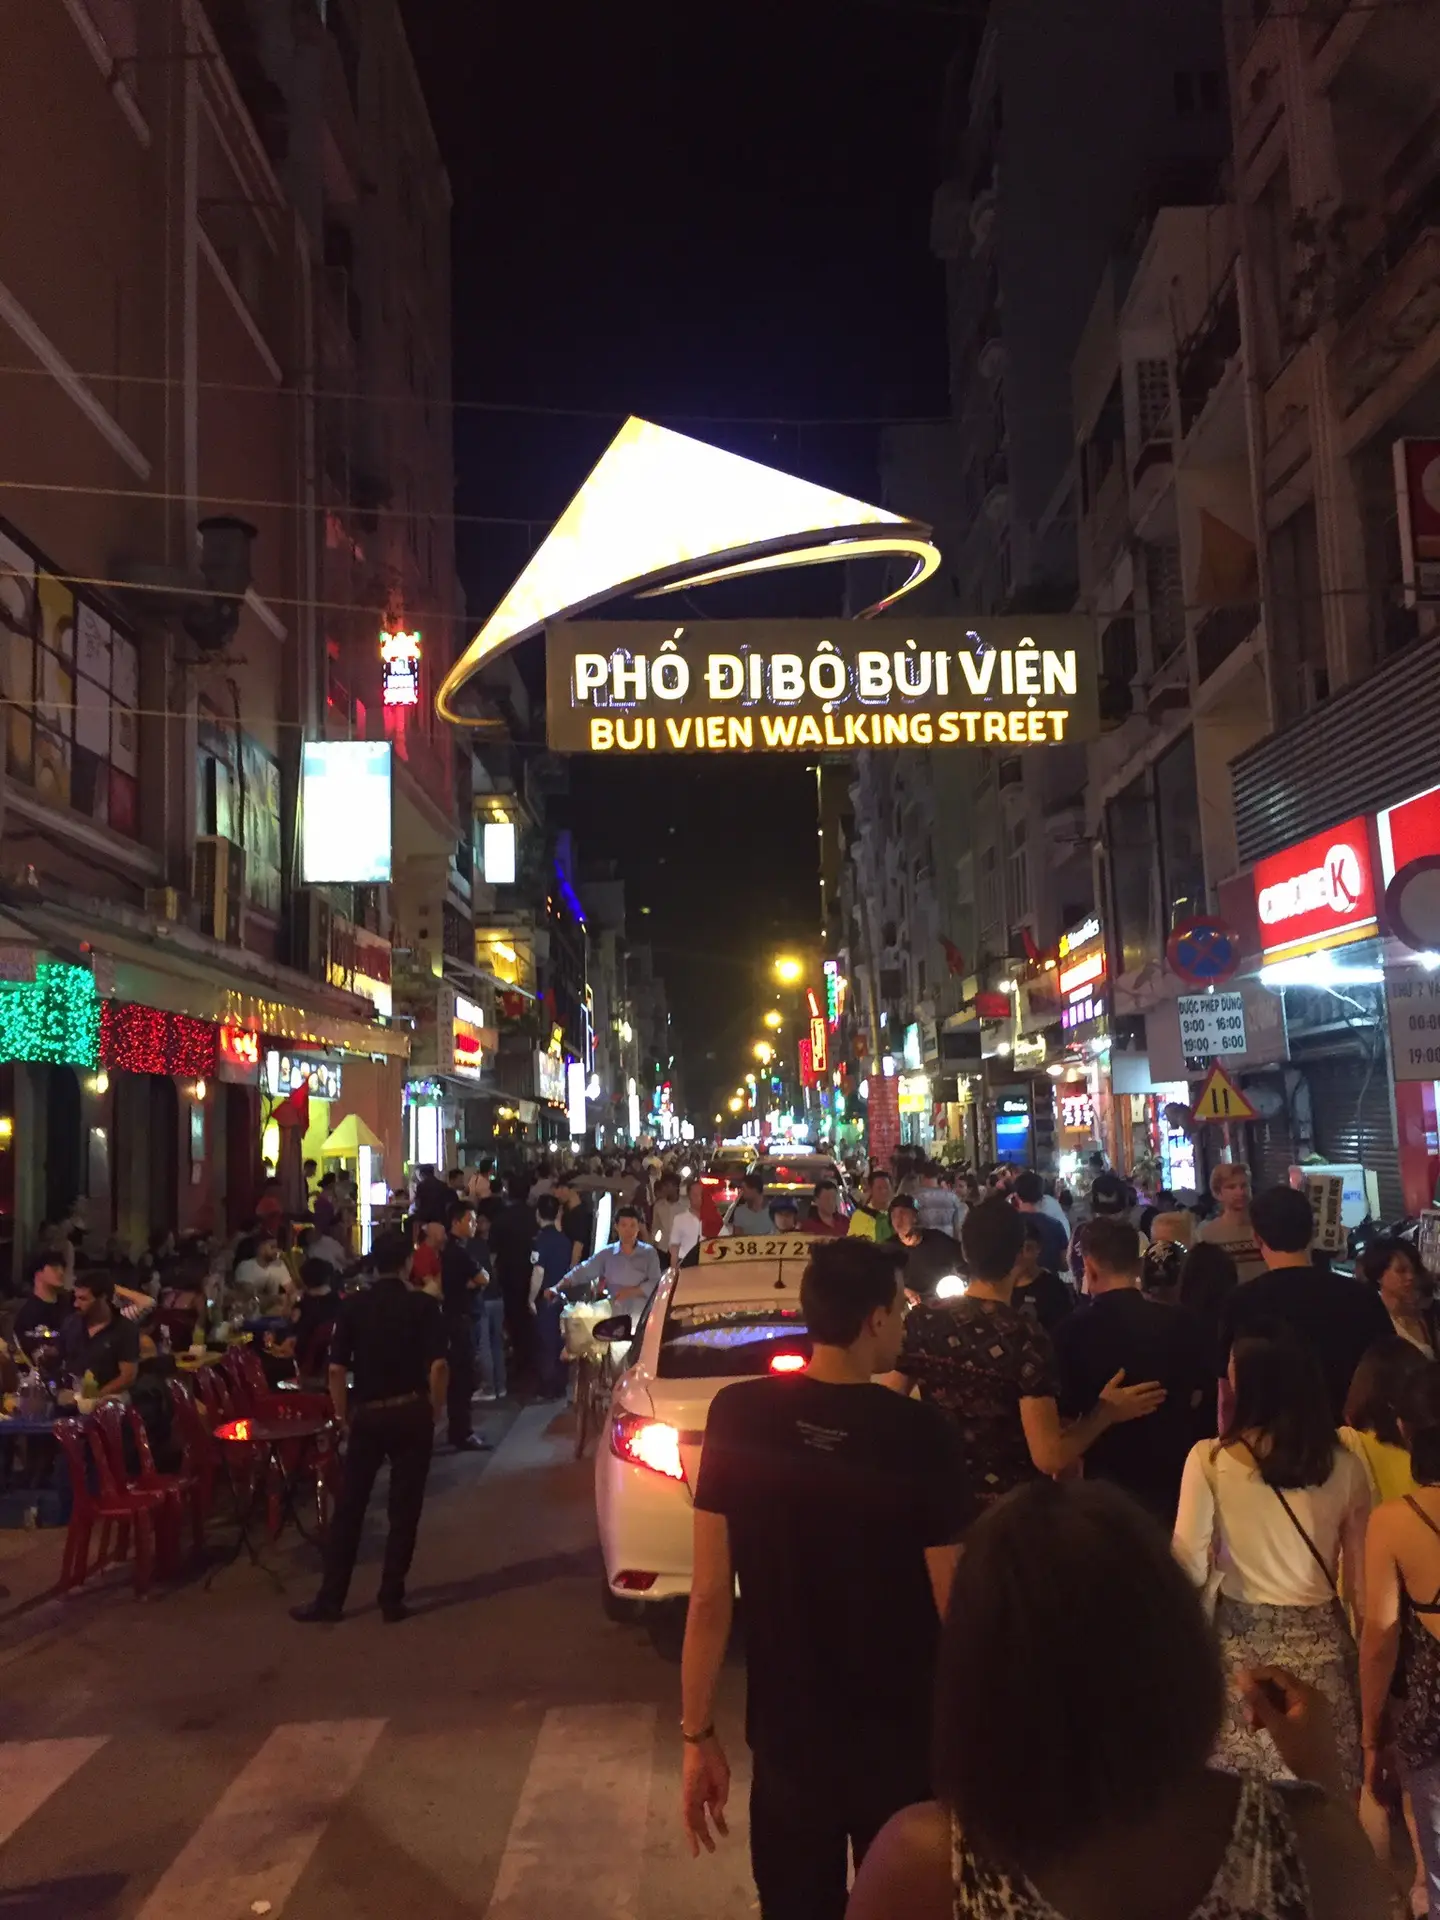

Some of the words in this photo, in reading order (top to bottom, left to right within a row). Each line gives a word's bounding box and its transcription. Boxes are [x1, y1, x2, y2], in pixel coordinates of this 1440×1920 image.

[575, 627, 690, 700] PHỐ
[858, 639, 949, 697] BÙI
[958, 637, 1077, 708] VIỆN
[590, 717, 656, 750] BUI
[666, 715, 753, 749] VIEN
[760, 713, 934, 747] WALKING
[938, 710, 1069, 743] STREET
[1182, 1018, 1205, 1033] 9:00
[1216, 1015, 1242, 1031] 16:00
[1183, 1037, 1210, 1052] 19:00
[1222, 1035, 1244, 1049] 6:00
[734, 1241, 788, 1255] 38.27
